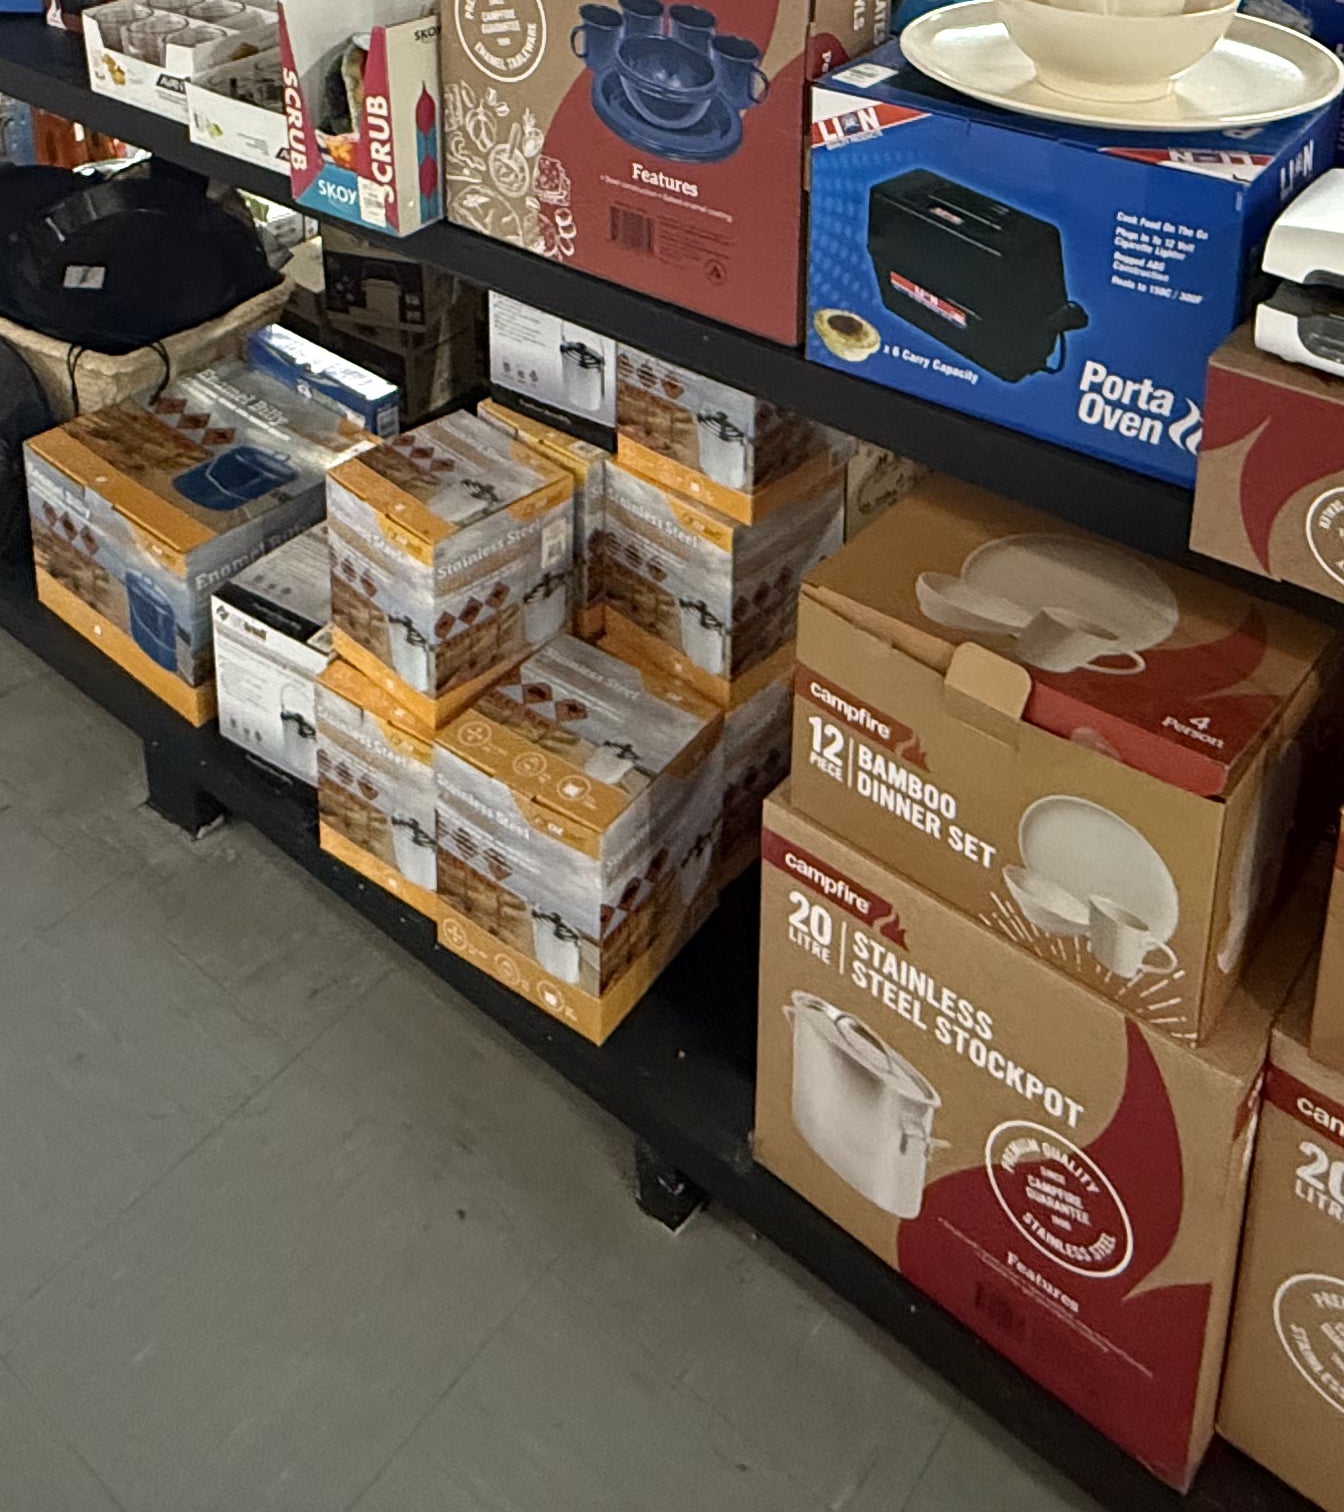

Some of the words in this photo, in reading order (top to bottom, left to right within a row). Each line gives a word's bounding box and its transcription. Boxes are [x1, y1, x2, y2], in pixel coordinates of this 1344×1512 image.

[282, 67, 308, 172] SCRUB
[317, 179, 357, 205] SKOY
[631, 162, 699, 197] Features
[1117, 211, 1138, 225] Cook
[1140, 217, 1162, 231] Food
[1163, 222, 1176, 233] On
[1178, 225, 1194, 237] The
[1196, 229, 1209, 240] Go
[1154, 246, 1187, 261] Lighter
[892, 345, 900, 357] 6
[901, 349, 931, 369] Carry
[932, 358, 979, 386] Capacity
[1079, 360, 1175, 417] Porta
[1078, 392, 1163, 445] Oven
[437, 537, 503, 579] Stainless
[505, 521, 542, 546] Steel
[810, 682, 890, 740] campfire
[1161, 716, 1225, 749] Person
[1189, 717, 1211, 731] 4
[809, 716, 844, 767] 12
[809, 751, 844, 783] PIECE
[858, 743, 956, 820] BAMBOO
[857, 770, 942, 840] DINNER
[948, 825, 996, 869] SET
[785, 852, 871, 915] campfire
[788, 890, 833, 947] 20
[788, 926, 831, 966] LITRE
[853, 930, 994, 1041] STAINLESS
[851, 960, 928, 1031] STEEL
[934, 1016, 1084, 1128] STOCKPOT
[1041, 1142, 1100, 1193] QUALITY
[1025, 1185, 1092, 1226] GUARANTEE
[1022, 1211, 1092, 1262] STAINLESS
[1007, 1250, 1079, 1313] Features
